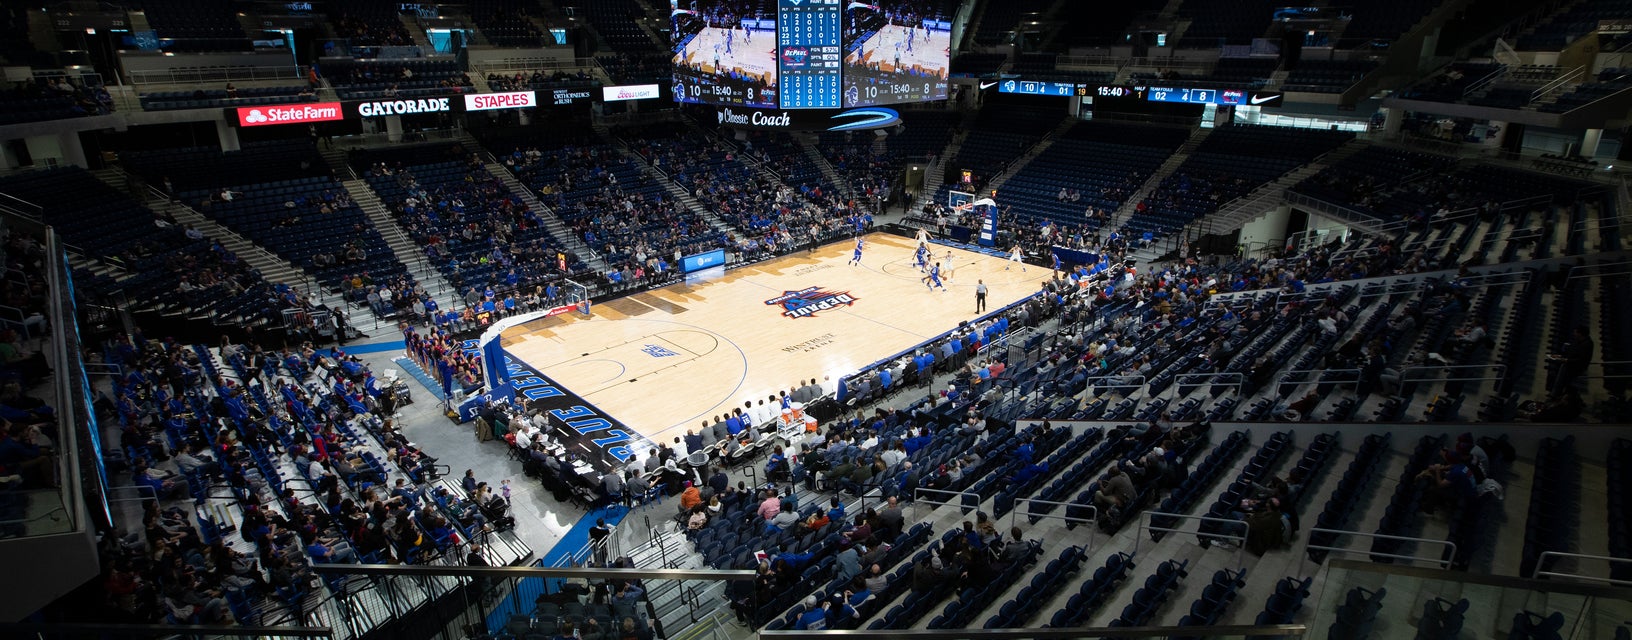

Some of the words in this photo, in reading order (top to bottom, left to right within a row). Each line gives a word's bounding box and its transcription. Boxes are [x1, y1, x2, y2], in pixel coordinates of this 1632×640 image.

[690, 86, 700, 96] 10
[712, 86, 731, 95] 15:40
[747, 87, 754, 99] 8
[865, 87, 877, 98] 10
[890, 84, 910, 94] 15:40
[924, 83, 930, 94] 8
[1097, 86, 1123, 96] 15:40
[1155, 92, 1166, 100] 02
[1200, 92, 1206, 100] 8
[359, 98, 450, 117] GATORADE
[474, 94, 529, 109] STAPLES
[724, 108, 748, 124] Classic
[752, 111, 790, 126] Coach
